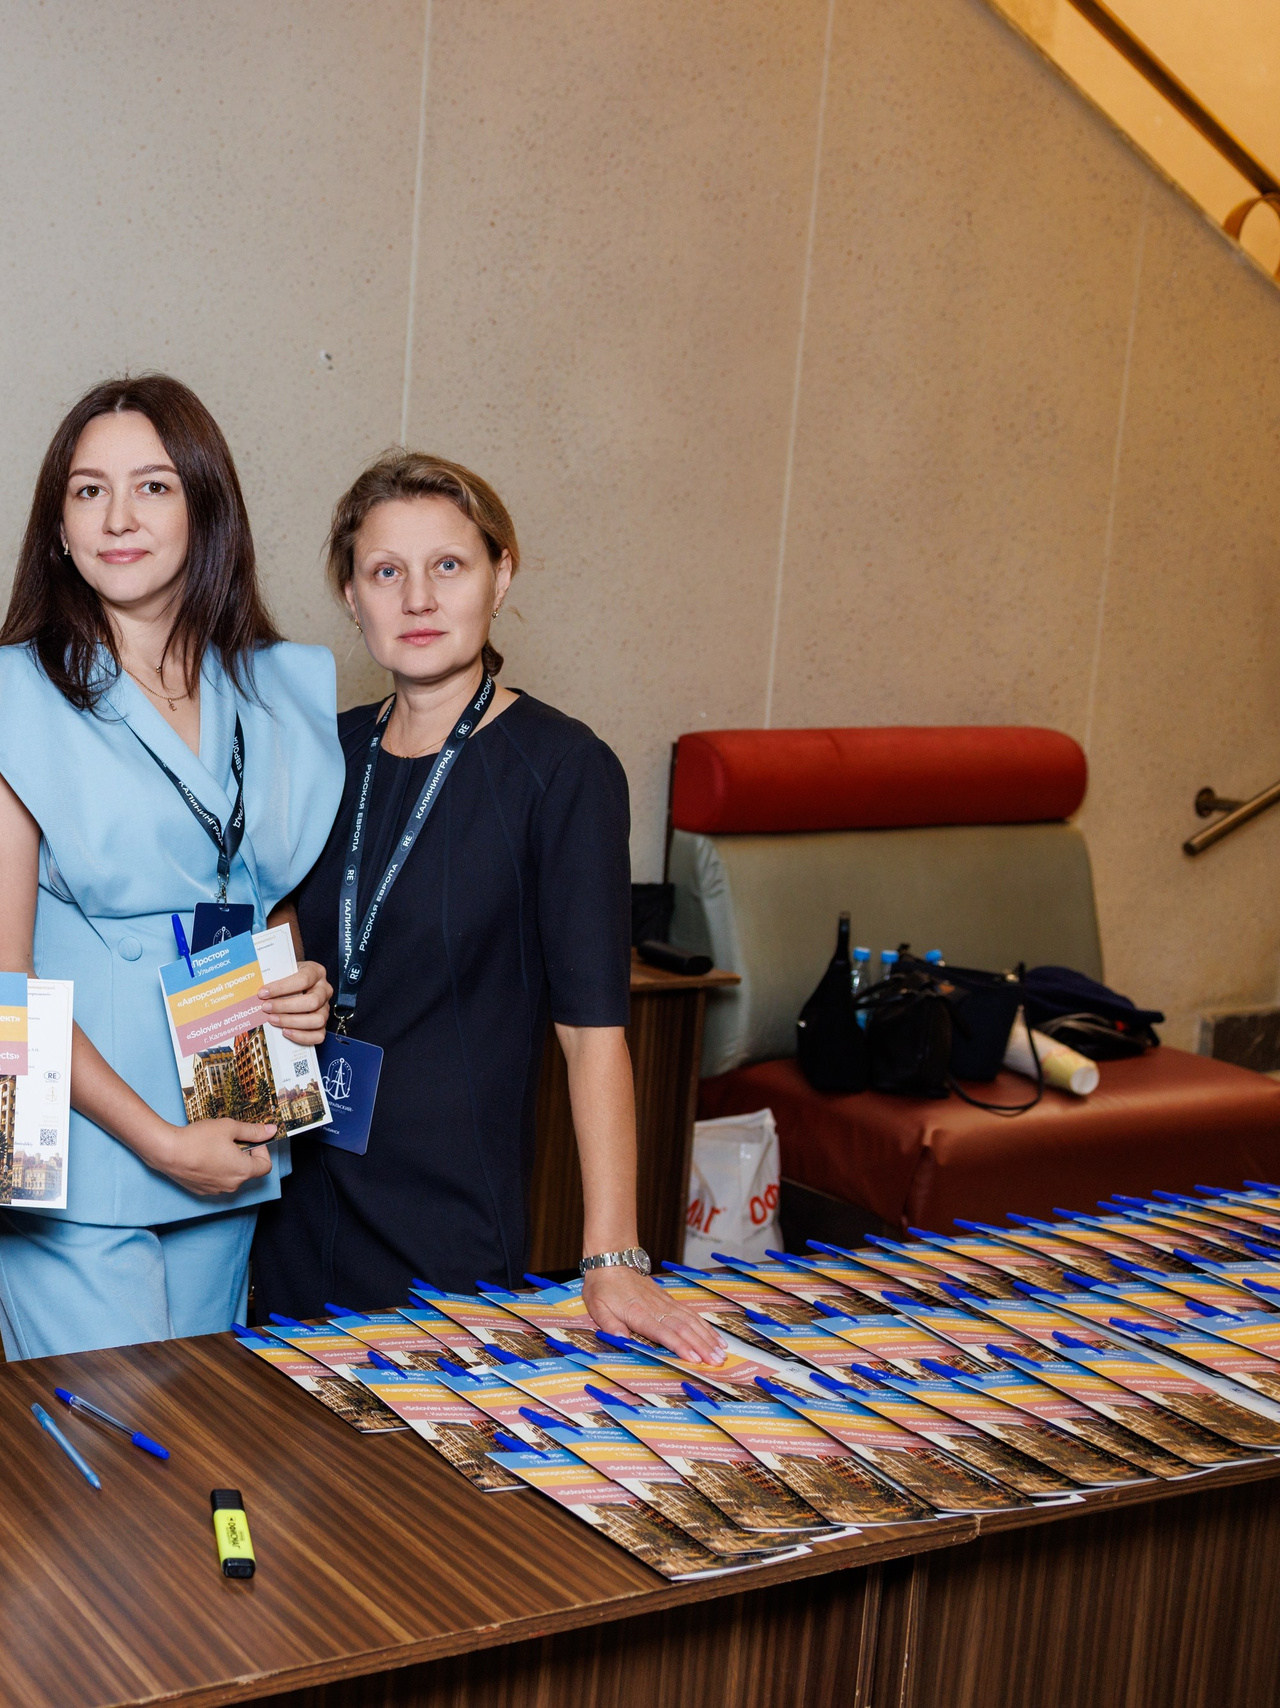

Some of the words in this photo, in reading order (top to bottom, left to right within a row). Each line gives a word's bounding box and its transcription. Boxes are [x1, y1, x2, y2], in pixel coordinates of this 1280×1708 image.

[458, 724, 470, 736] RE
[358, 764, 372, 810] РУССКАЯ
[415, 749, 455, 819] КАЛИНИНГРАД
[351, 811, 364, 852] ЕВРОПА
[402, 834, 413, 847] RE
[346, 869, 355, 881] RE
[359, 904, 378, 951] РУССКАЯ
[376, 863, 398, 902] ЕВРОПА
[344, 898, 352, 973] КАЛИНИНГ
[196, 958, 231, 977] Ульяновск
[349, 967, 360, 980] RE
[177, 984, 224, 1008] «Авторский
[224, 972, 255, 989] проект»
[210, 992, 235, 1006] Тюмень
[186, 1021, 222, 1040] «Soloviev
[223, 1004, 262, 1025] architects»
[209, 1020, 251, 1041] Калининград
